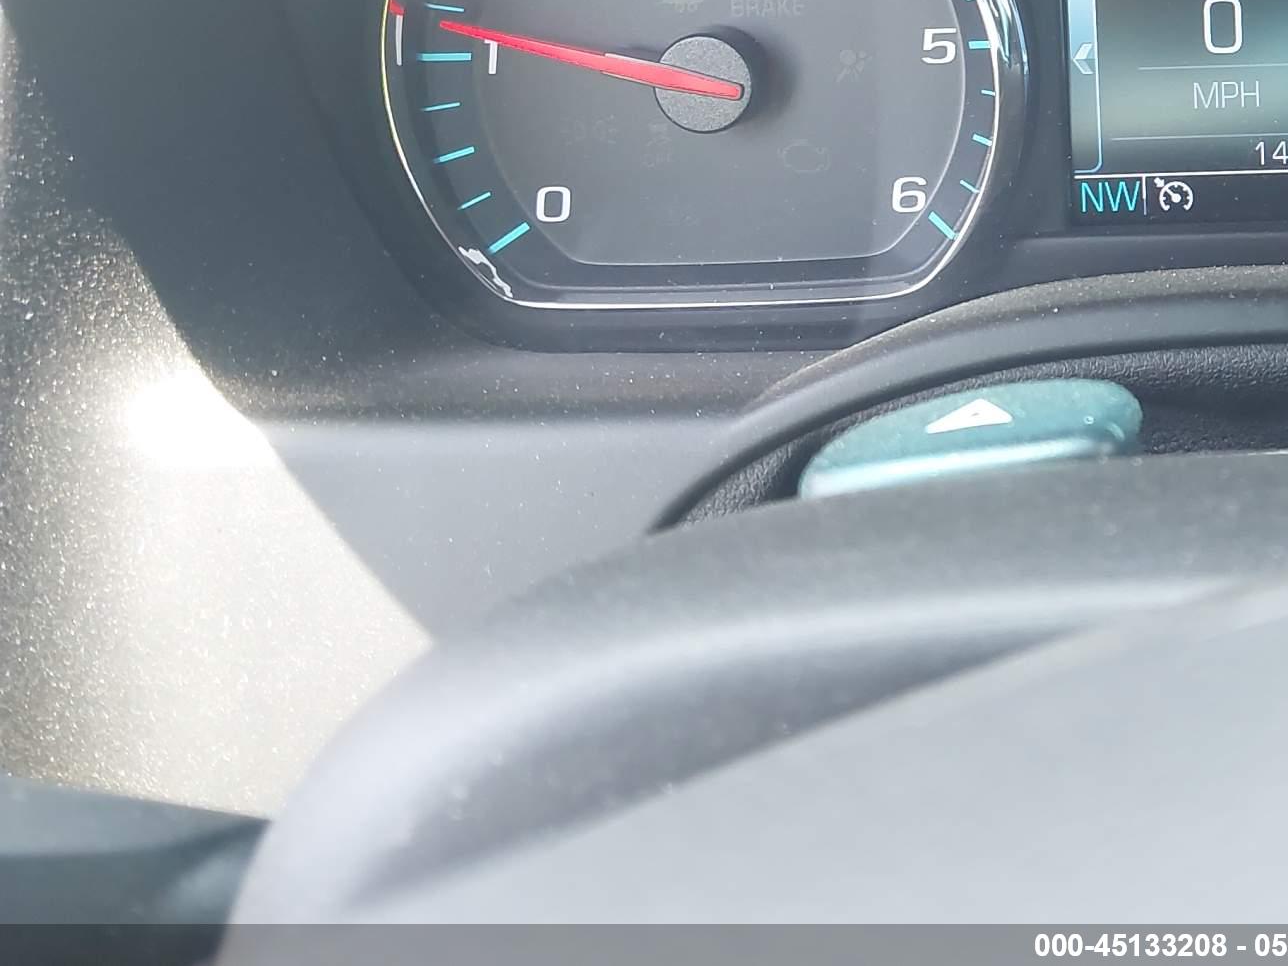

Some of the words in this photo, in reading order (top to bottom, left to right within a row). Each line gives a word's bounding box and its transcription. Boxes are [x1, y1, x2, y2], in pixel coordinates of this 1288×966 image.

[921, 27, 957, 64] 5
[1193, 80, 1260, 109] MPH
[536, 186, 571, 223] 0
[892, 176, 928, 214] 6
[1080, 181, 1140, 213] NW
